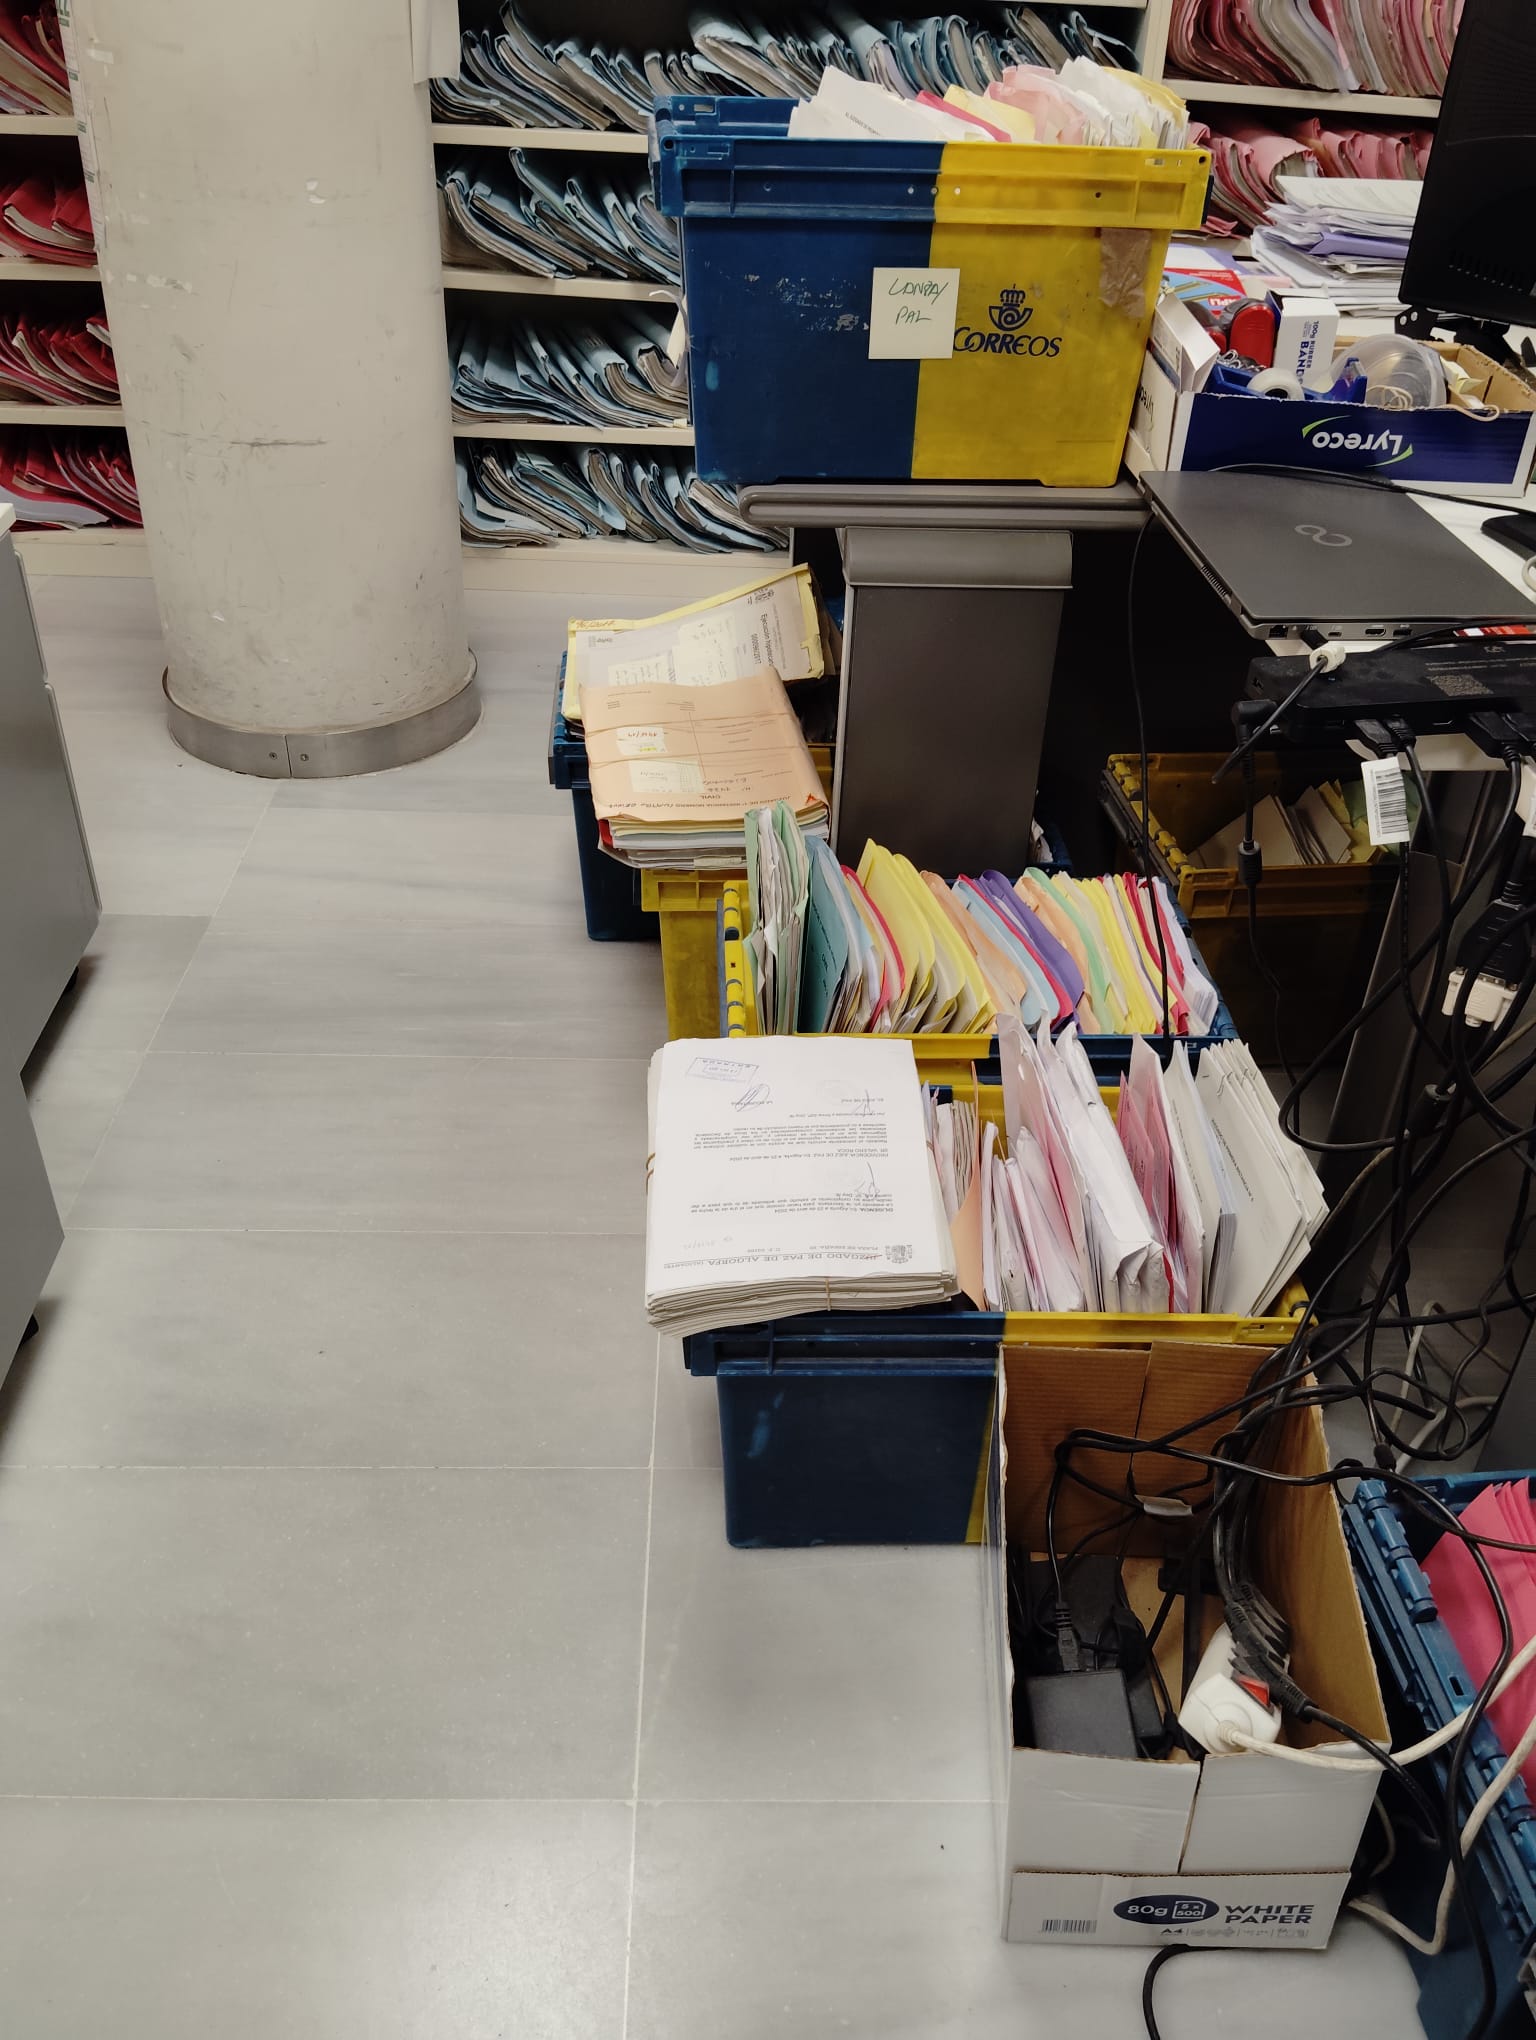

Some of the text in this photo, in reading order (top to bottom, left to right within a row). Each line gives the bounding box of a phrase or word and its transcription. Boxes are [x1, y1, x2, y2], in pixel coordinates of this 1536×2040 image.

[953, 326, 1063, 358] CORREOS
[1312, 429, 1403, 456] Lyreco
[763, 1255, 779, 1263] DE
[1127, 1903, 1168, 1917] 80g
[1224, 1904, 1315, 1914] WHITE
[1224, 1914, 1312, 1924] PAPER
[1160, 1928, 1183, 1936] A4
